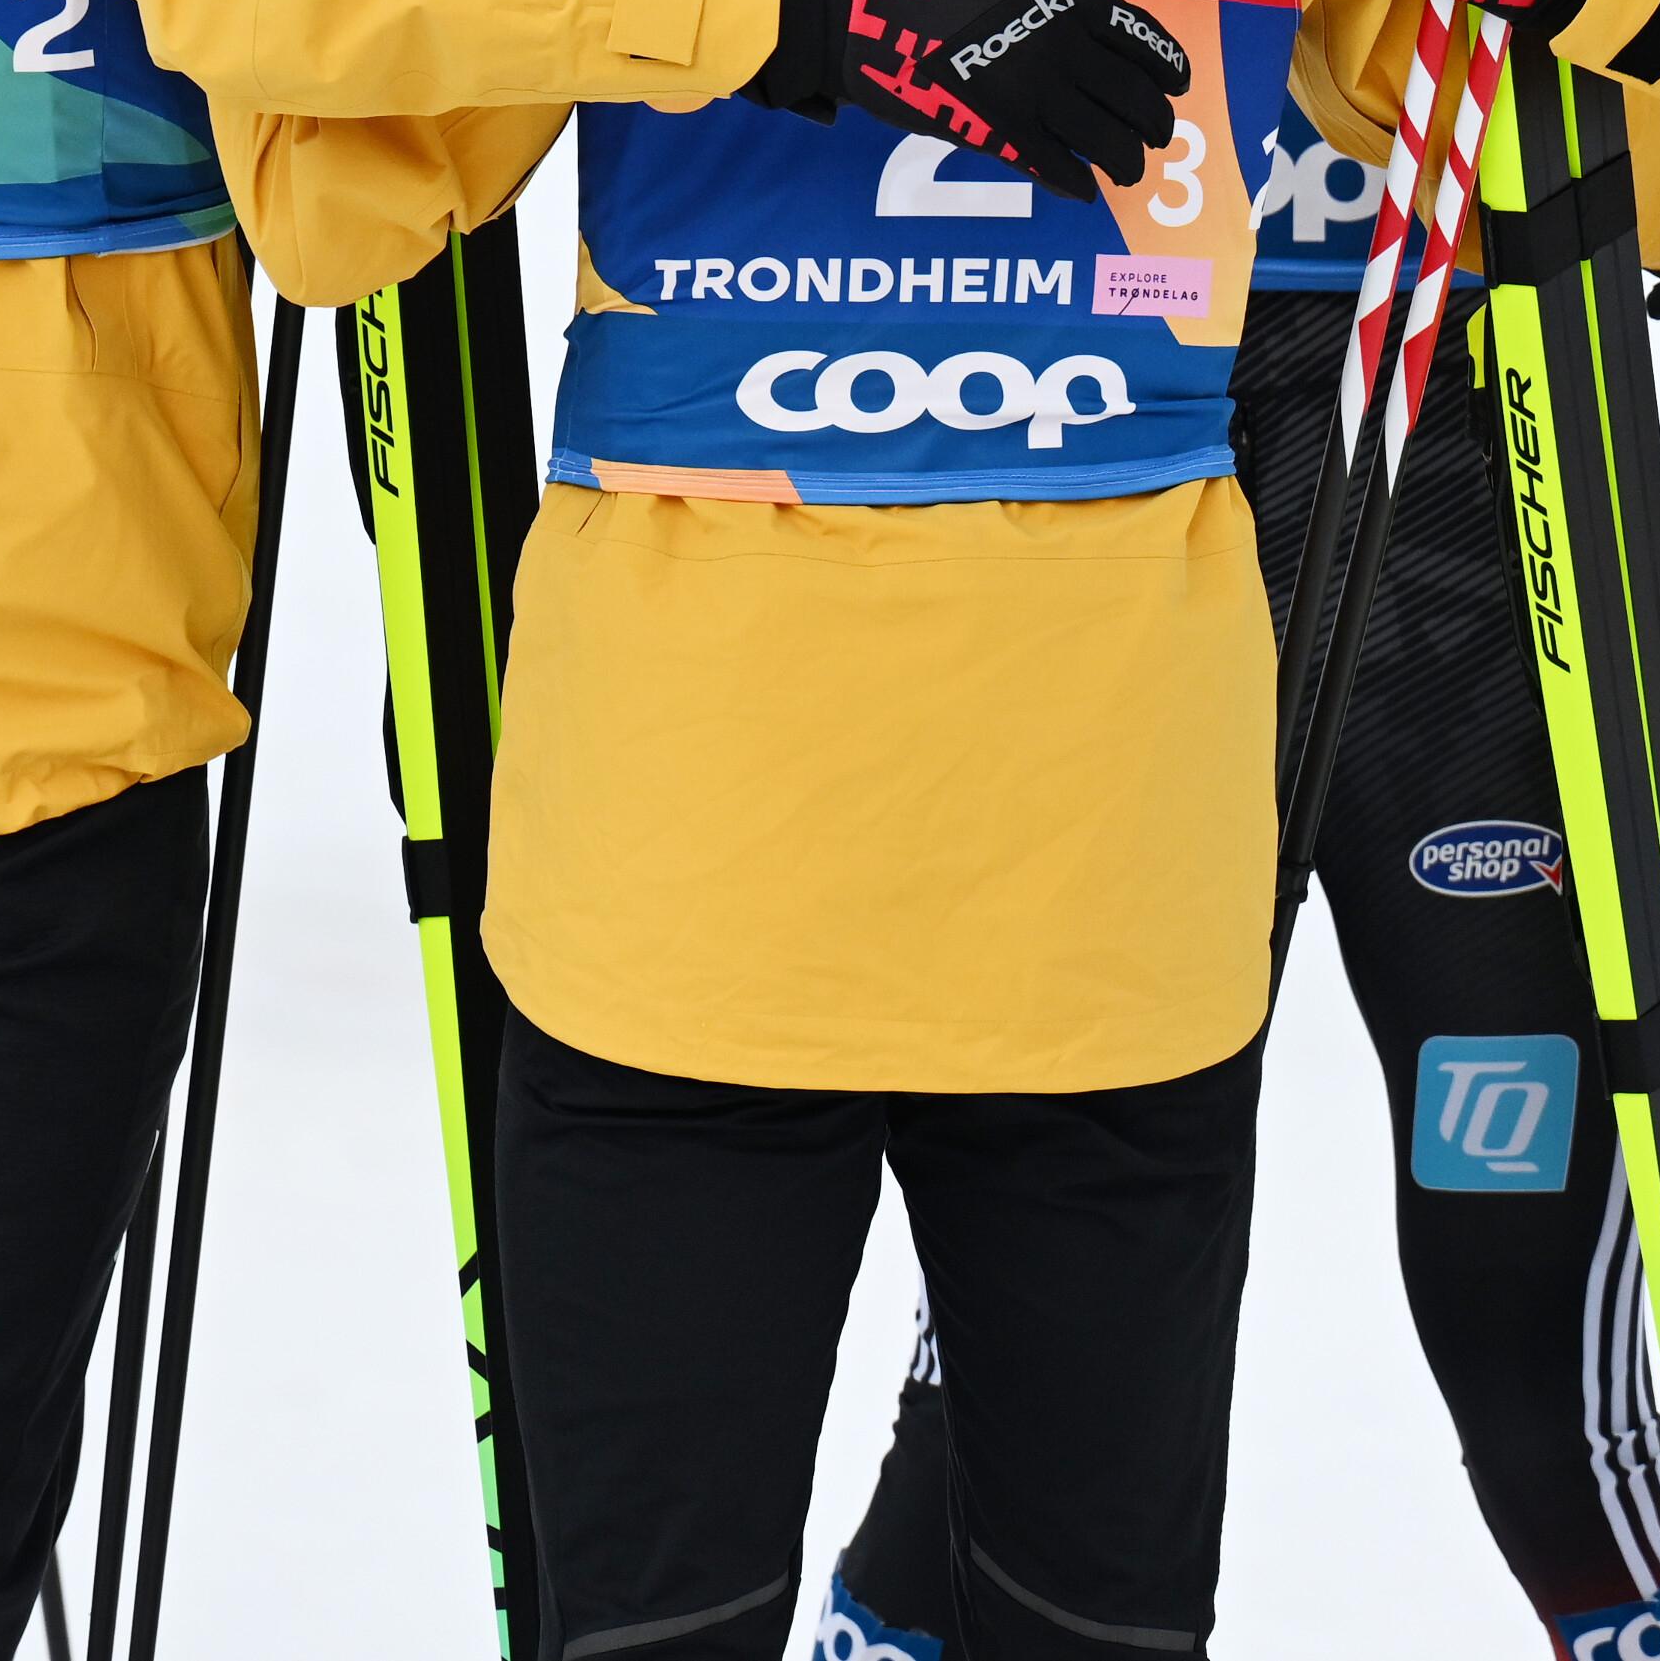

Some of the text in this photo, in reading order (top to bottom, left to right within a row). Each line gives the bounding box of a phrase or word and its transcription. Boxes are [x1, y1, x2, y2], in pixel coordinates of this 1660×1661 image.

[1146, 119, 1207, 228] 3
[654, 256, 1073, 304] TRONDHEIM
[1108, 287, 1199, 301] TRØNDELAG
[1110, 272, 1168, 284] EXPLORE
[360, 286, 399, 498] FISCH
[735, 349, 1137, 449] coop
[1505, 366, 1571, 674] FISCHER
[1422, 836, 1550, 870] personal
[1447, 856, 1521, 883] shop
[1437, 1061, 1550, 1172] TQ
